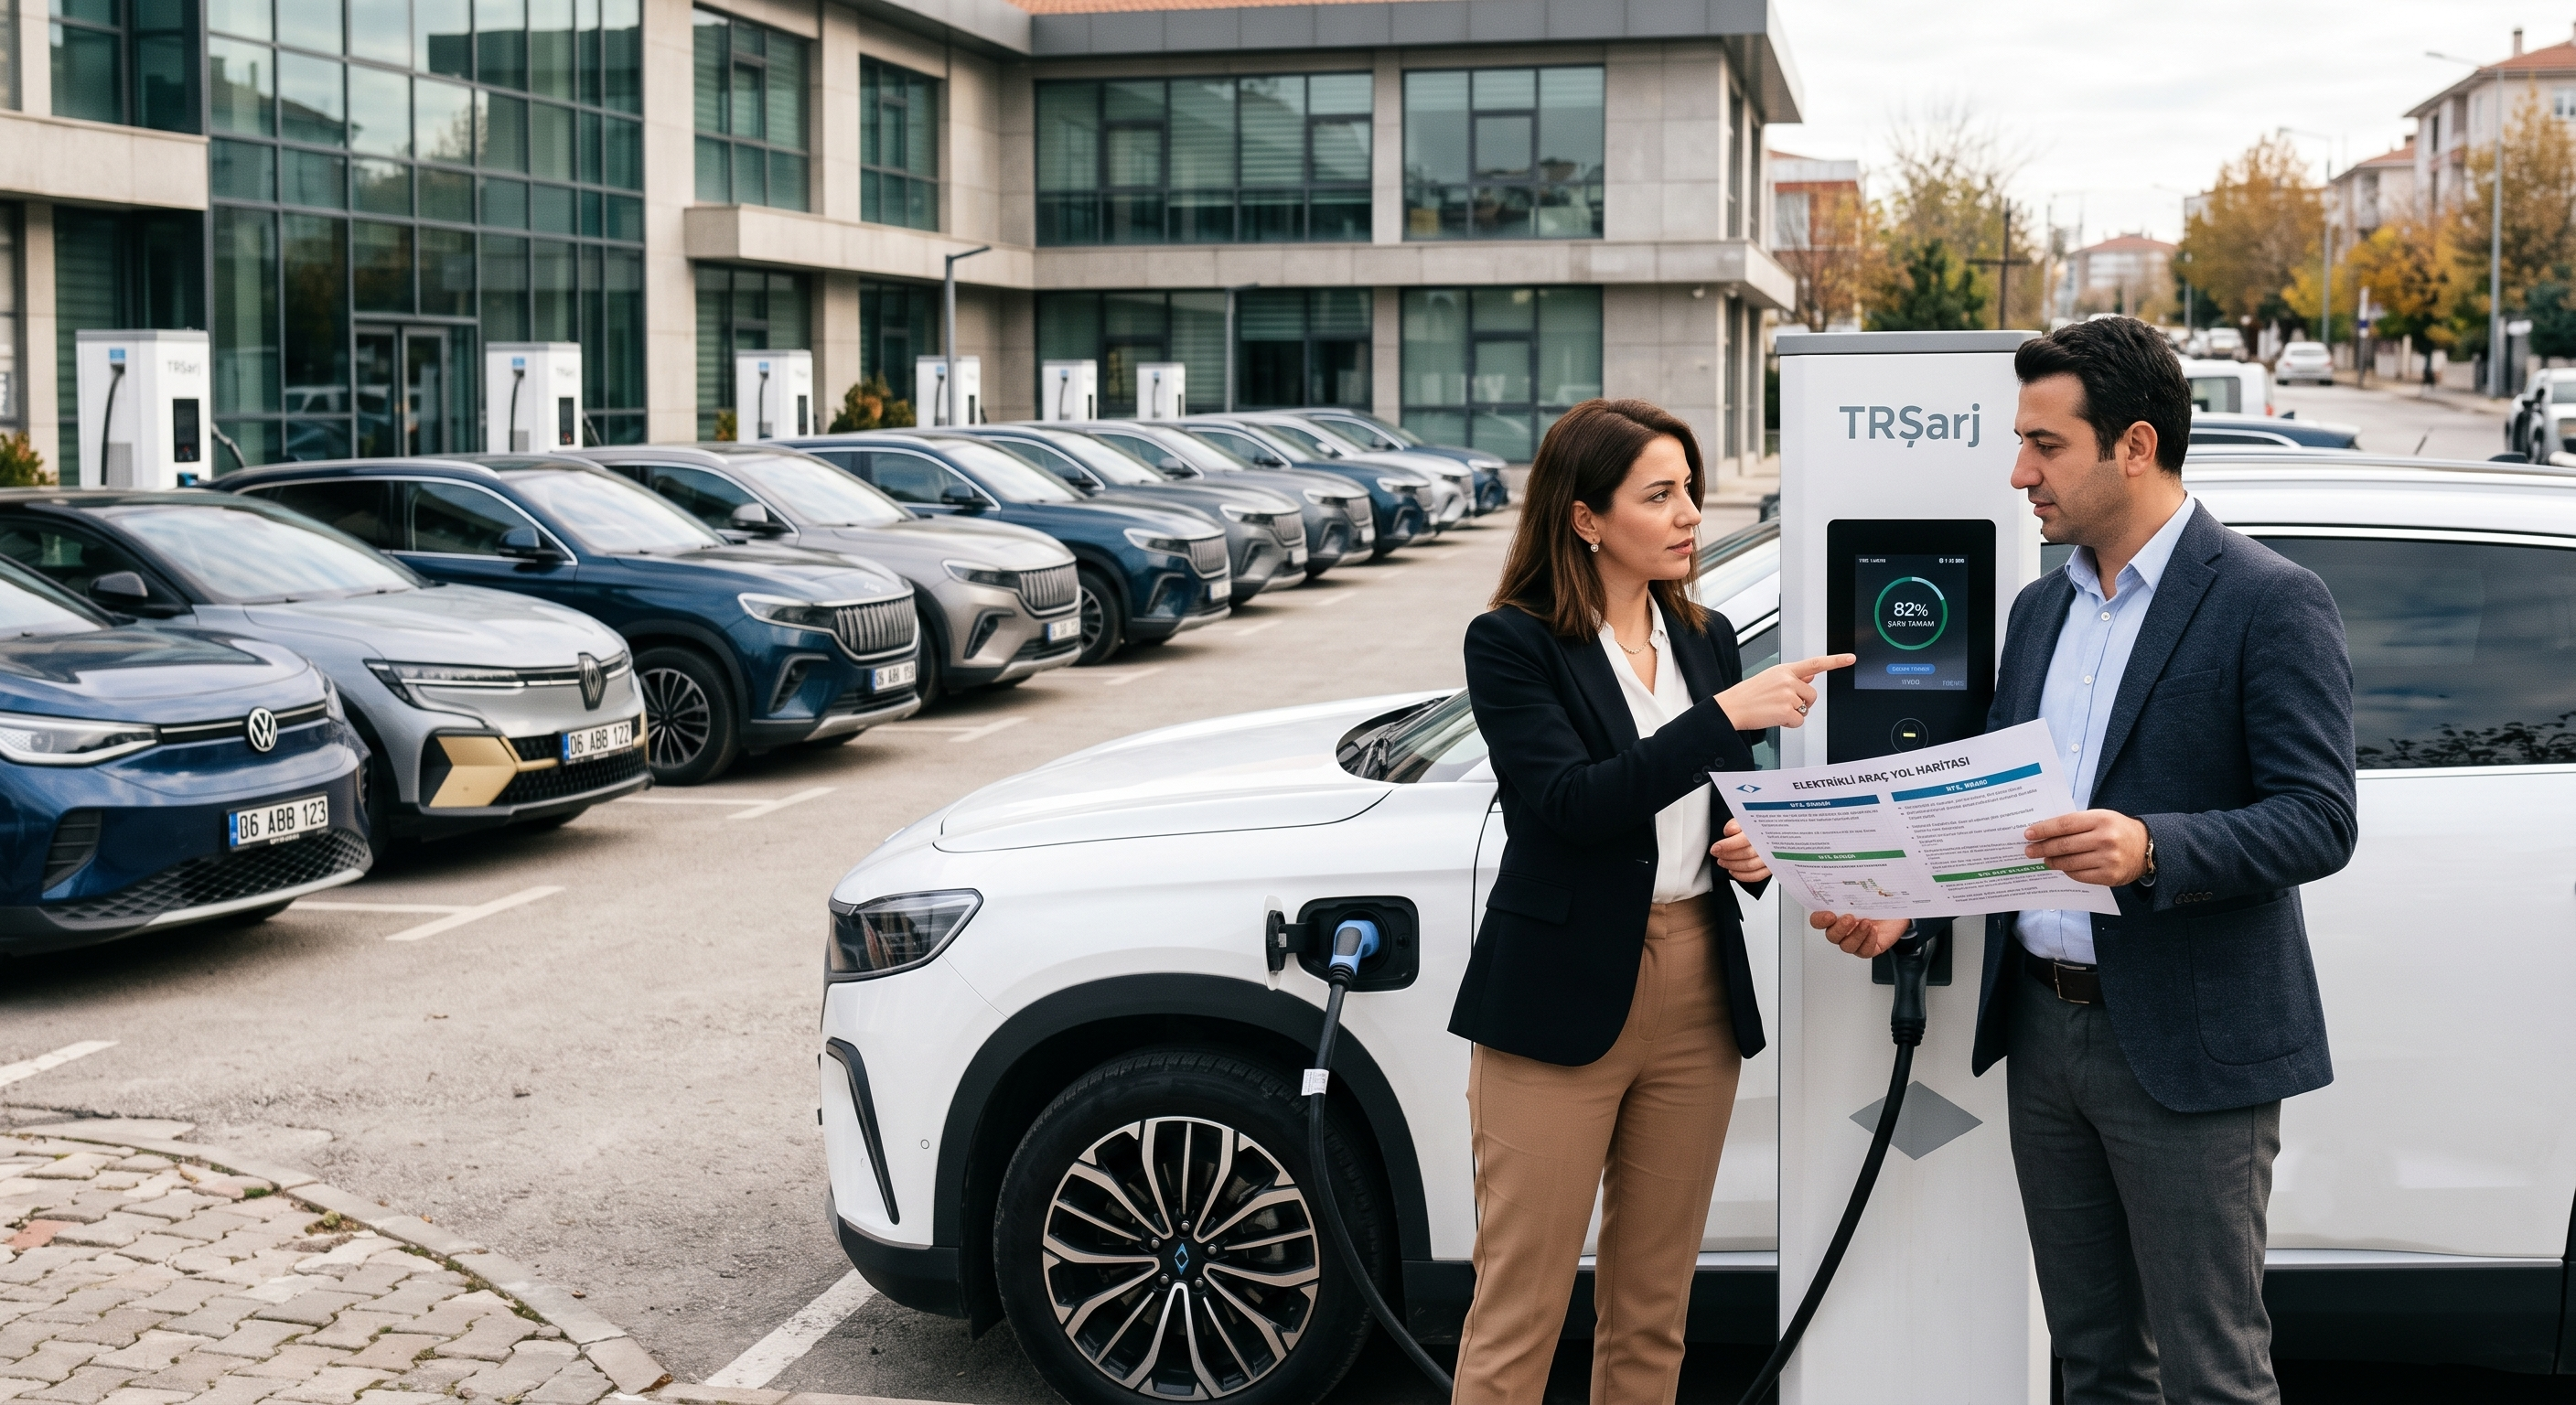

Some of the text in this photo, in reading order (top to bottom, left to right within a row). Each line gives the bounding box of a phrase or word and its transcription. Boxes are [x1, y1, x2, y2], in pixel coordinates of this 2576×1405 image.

[1839, 402, 1980, 448] TRŞarj
[1894, 601, 1928, 617] 82%
[570, 734, 584, 756] 06
[1792, 756, 1970, 790] ELEKTRİKLİ ARAÇ YOL HARİTASI
[268, 806, 295, 835] ABB
[303, 800, 327, 827] 123
